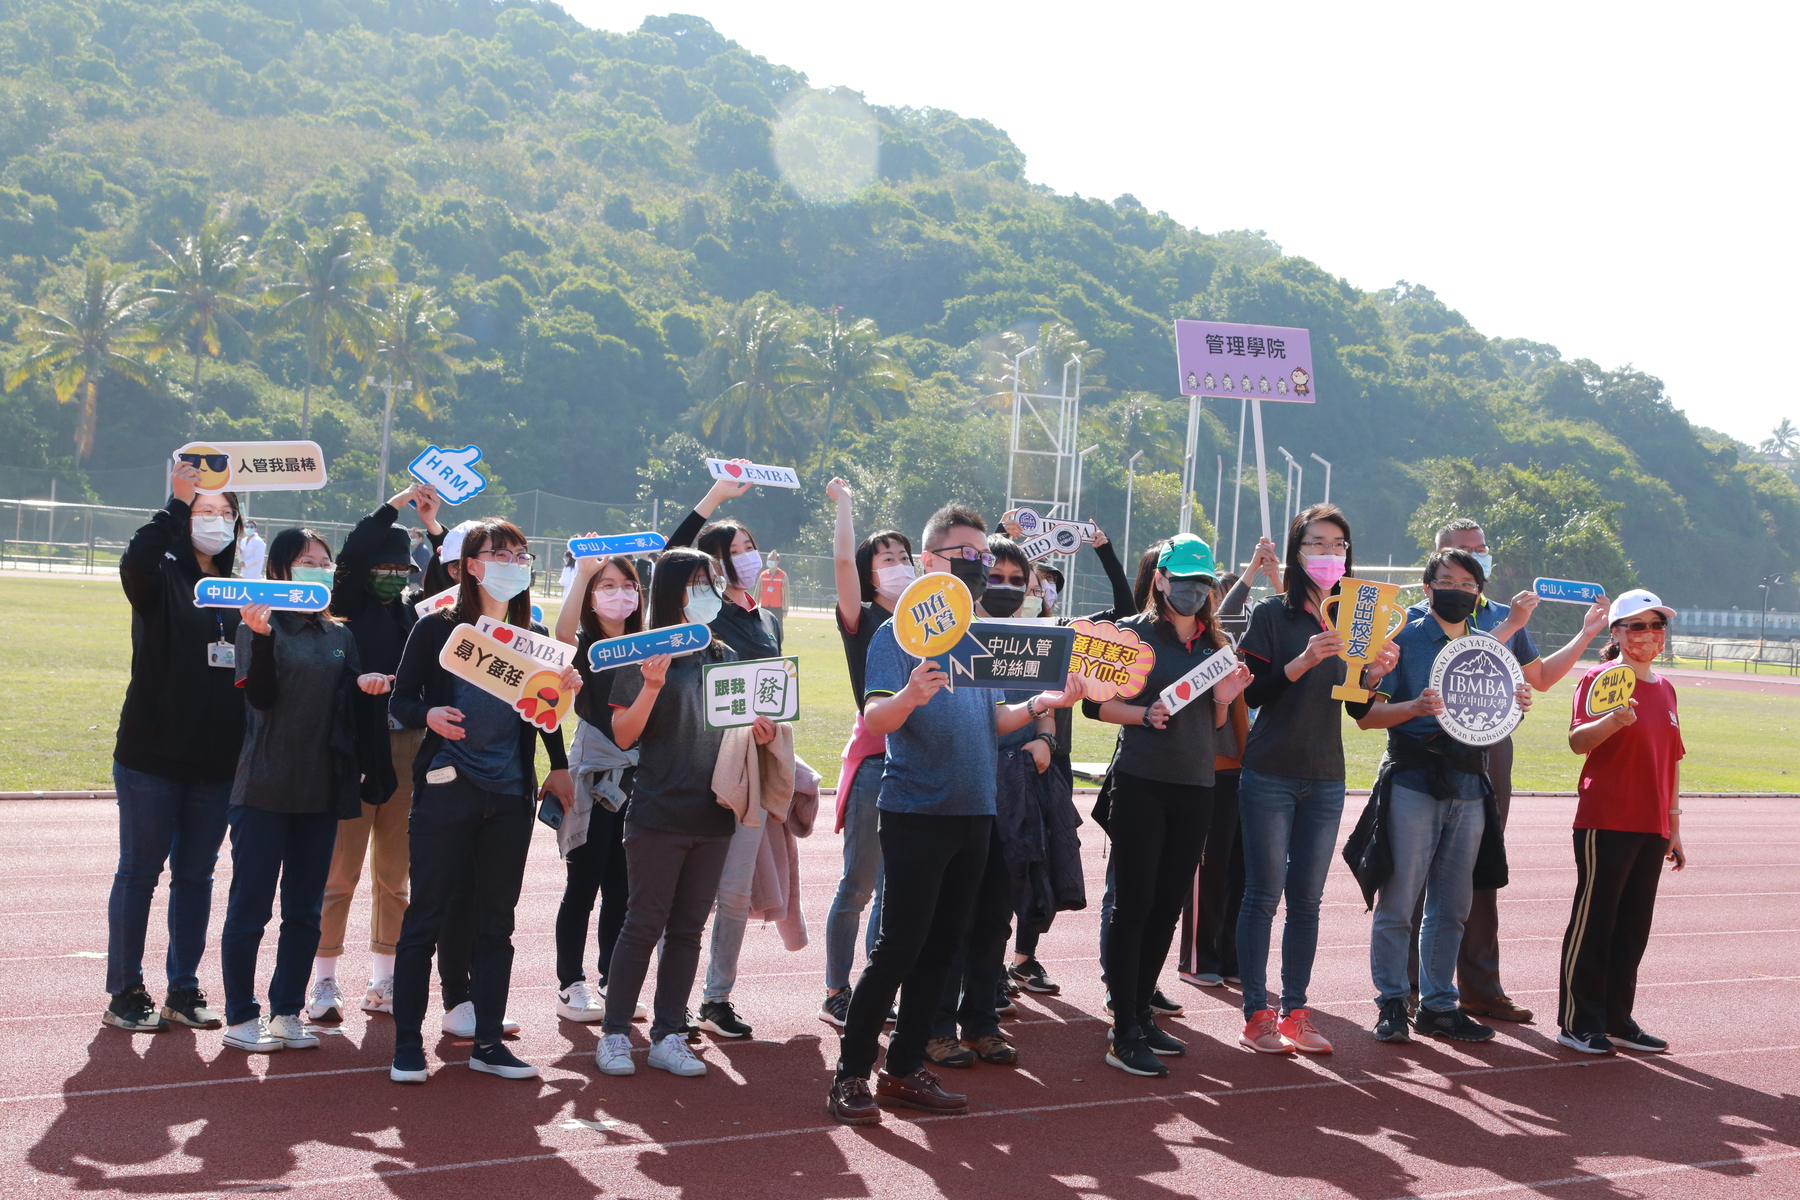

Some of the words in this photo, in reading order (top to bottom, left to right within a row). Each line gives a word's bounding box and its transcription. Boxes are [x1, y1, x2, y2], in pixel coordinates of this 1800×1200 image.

[1205, 333, 1286, 359] 管理學院
[238, 457, 316, 473] 人管我最棒
[426, 455, 469, 492] HRM
[713, 463, 723, 474] I
[744, 467, 795, 483] EMBA
[909, 588, 950, 626] 功在
[922, 608, 958, 645] 人管
[1346, 584, 1378, 659] 傑出校友
[512, 635, 565, 667] EMBA
[988, 636, 1052, 657] 中山人管
[1072, 634, 1139, 665] 企業最愛
[1449, 641, 1467, 656] SUN
[1469, 639, 1506, 657] YAT-SEN
[454, 638, 525, 687] 我愛人管
[991, 659, 1041, 678] 粉絲團
[1068, 655, 1130, 685] 中山人管
[715, 678, 746, 697] 跟我
[756, 677, 783, 706] 發
[1166, 693, 1177, 707] I
[1191, 655, 1234, 691] EMBA
[1449, 675, 1508, 698] IBMBA
[1602, 670, 1626, 688] 中山人
[715, 699, 746, 715] 一起
[1447, 693, 1508, 710] 國立中山大學
[1599, 688, 1624, 705] 一家人
[1441, 713, 1468, 739] Taiwan
[1470, 721, 1514, 742] Kaohsiung
